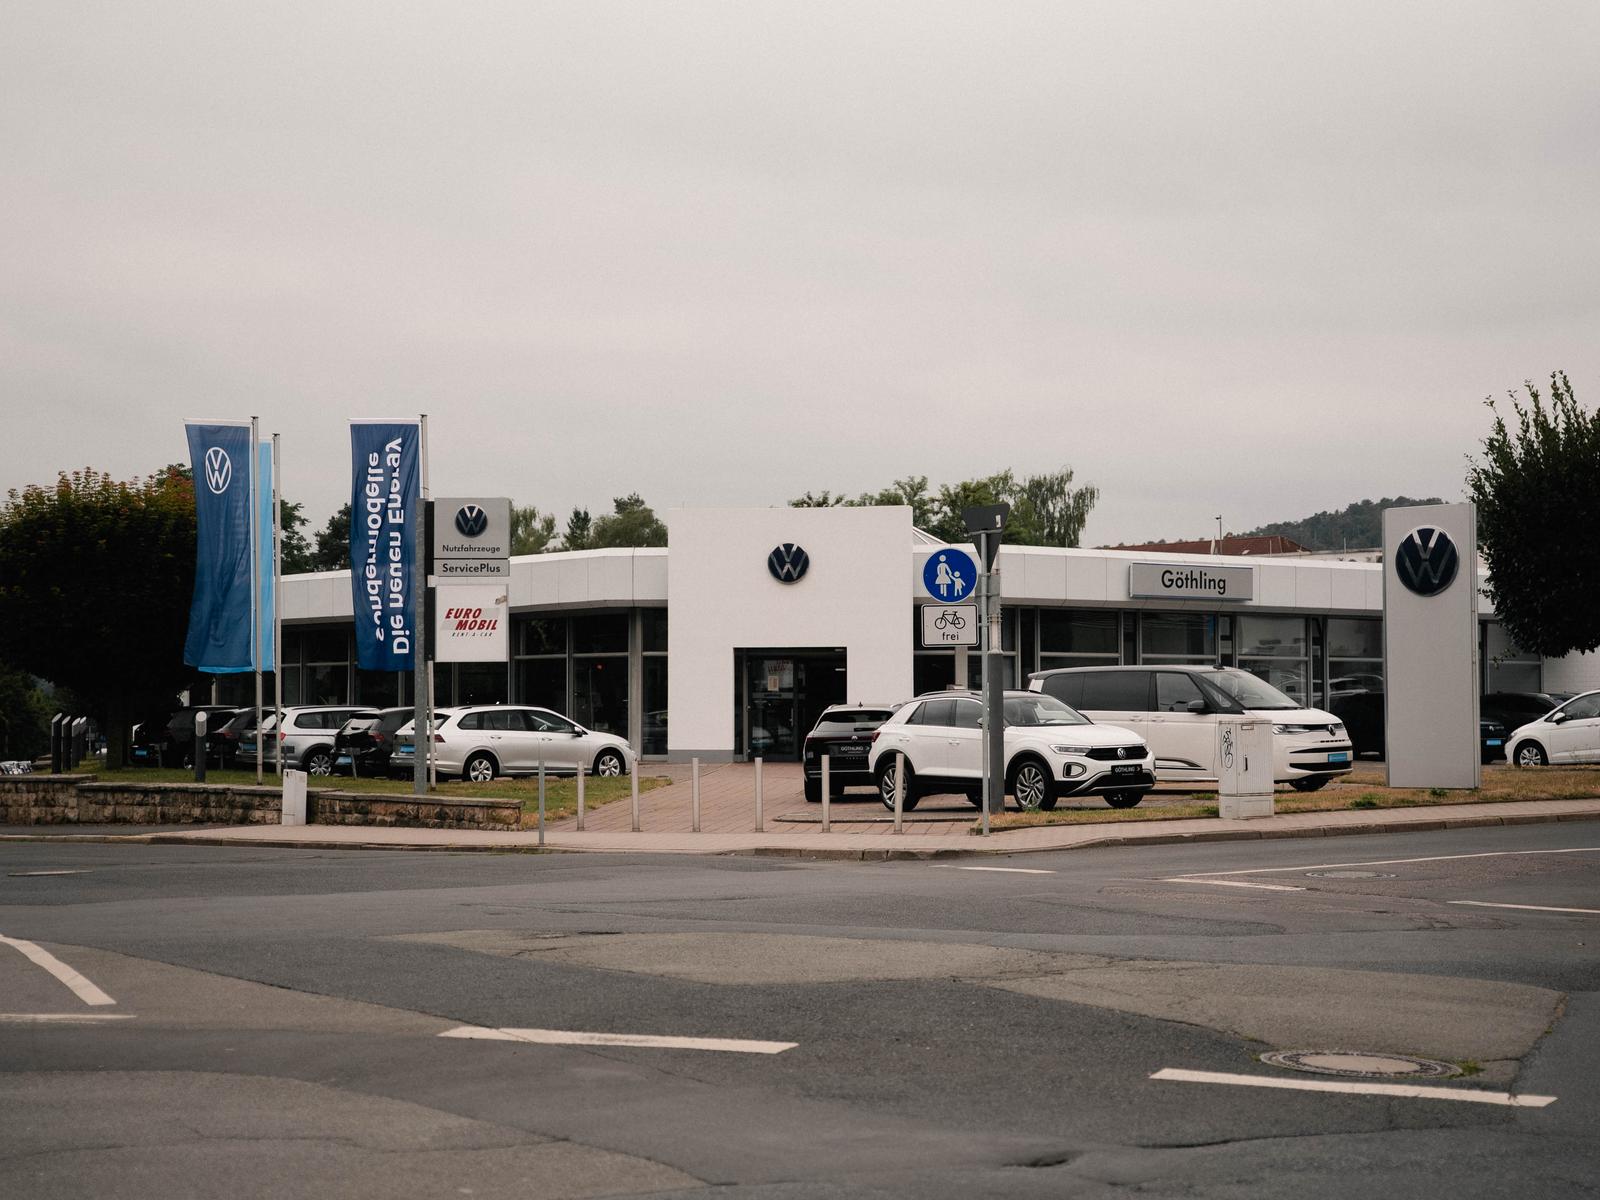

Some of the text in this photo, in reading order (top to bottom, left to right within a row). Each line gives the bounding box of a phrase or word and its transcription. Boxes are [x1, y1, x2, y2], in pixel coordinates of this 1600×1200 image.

[442, 544, 501, 554] Nutzfahrzeuge
[767, 542, 810, 585] VW
[1396, 525, 1460, 597] VW
[442, 563, 501, 573] ServicePlus
[1161, 569, 1226, 595] Göthling
[445, 608, 482, 619] EURO
[455, 620, 498, 631] MOBIL
[942, 631, 959, 641] frei
